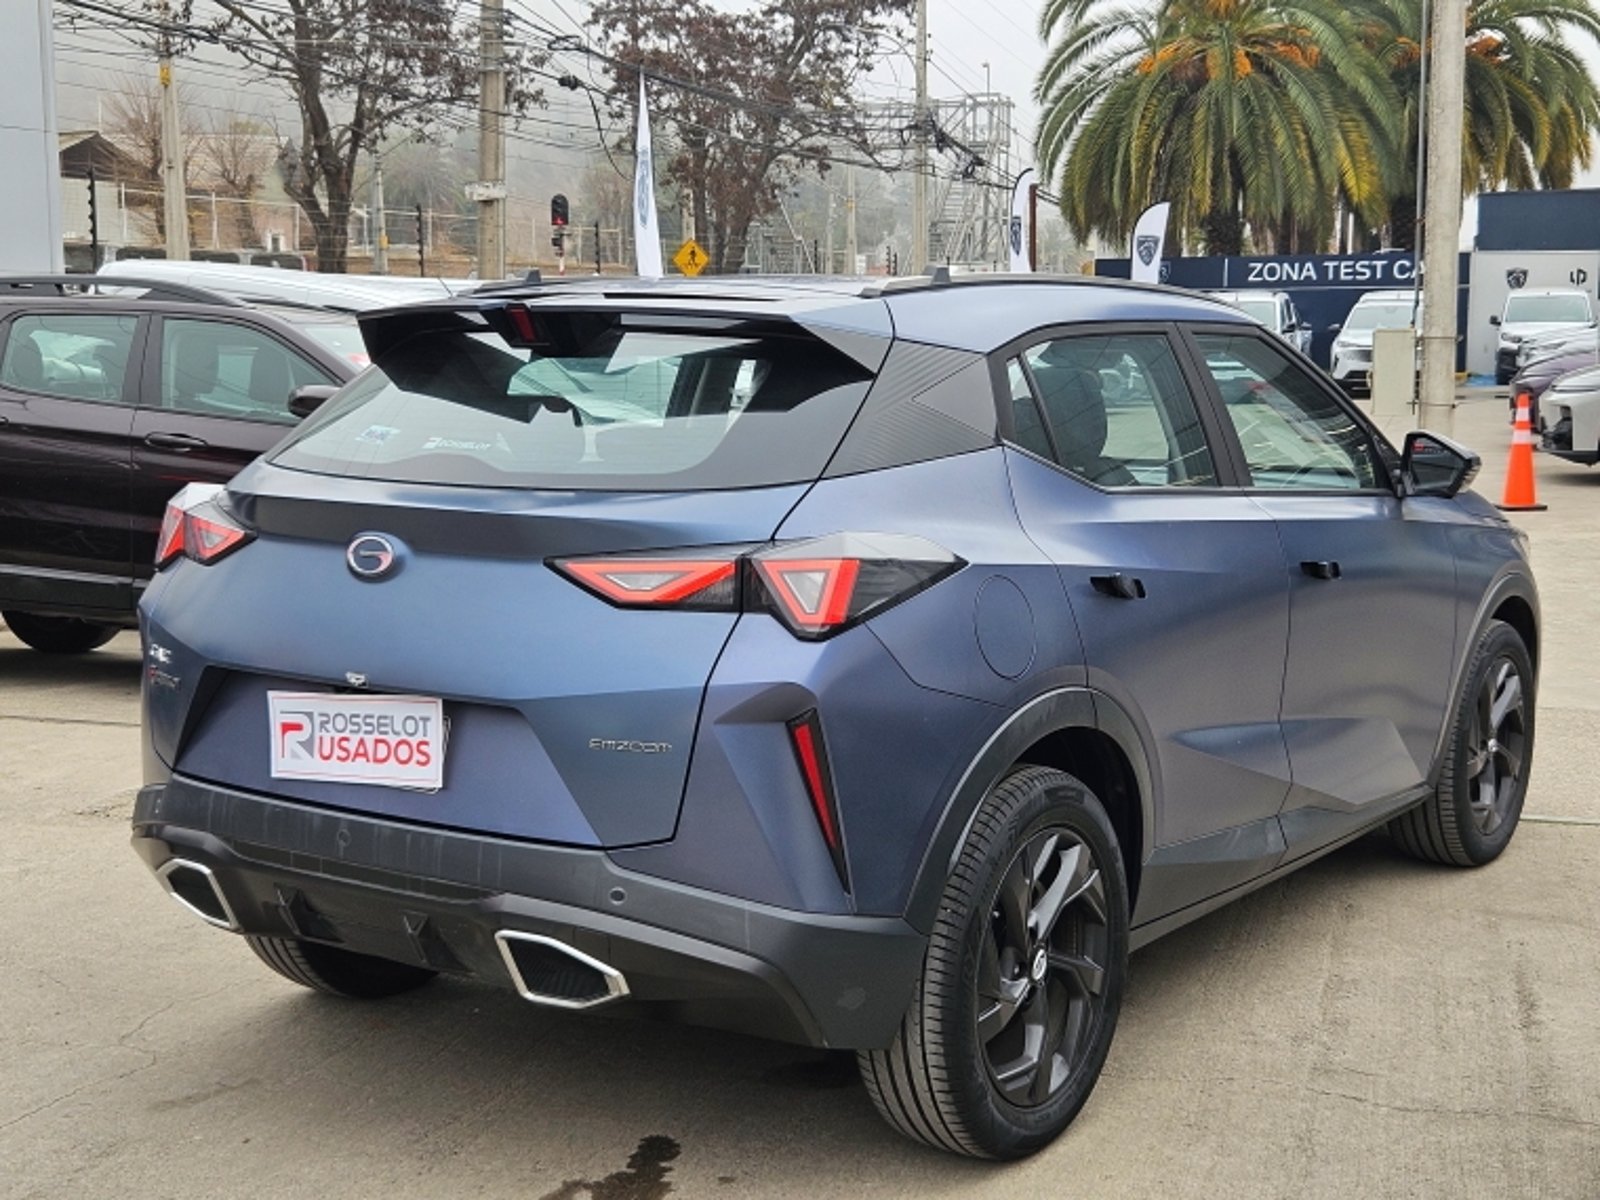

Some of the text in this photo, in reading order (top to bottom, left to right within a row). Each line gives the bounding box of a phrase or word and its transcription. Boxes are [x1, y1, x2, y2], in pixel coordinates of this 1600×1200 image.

[1248, 260, 1425, 281] ZONA TEST CA
[318, 712, 432, 738] ROSSELOT
[318, 735, 432, 767] USADOS
